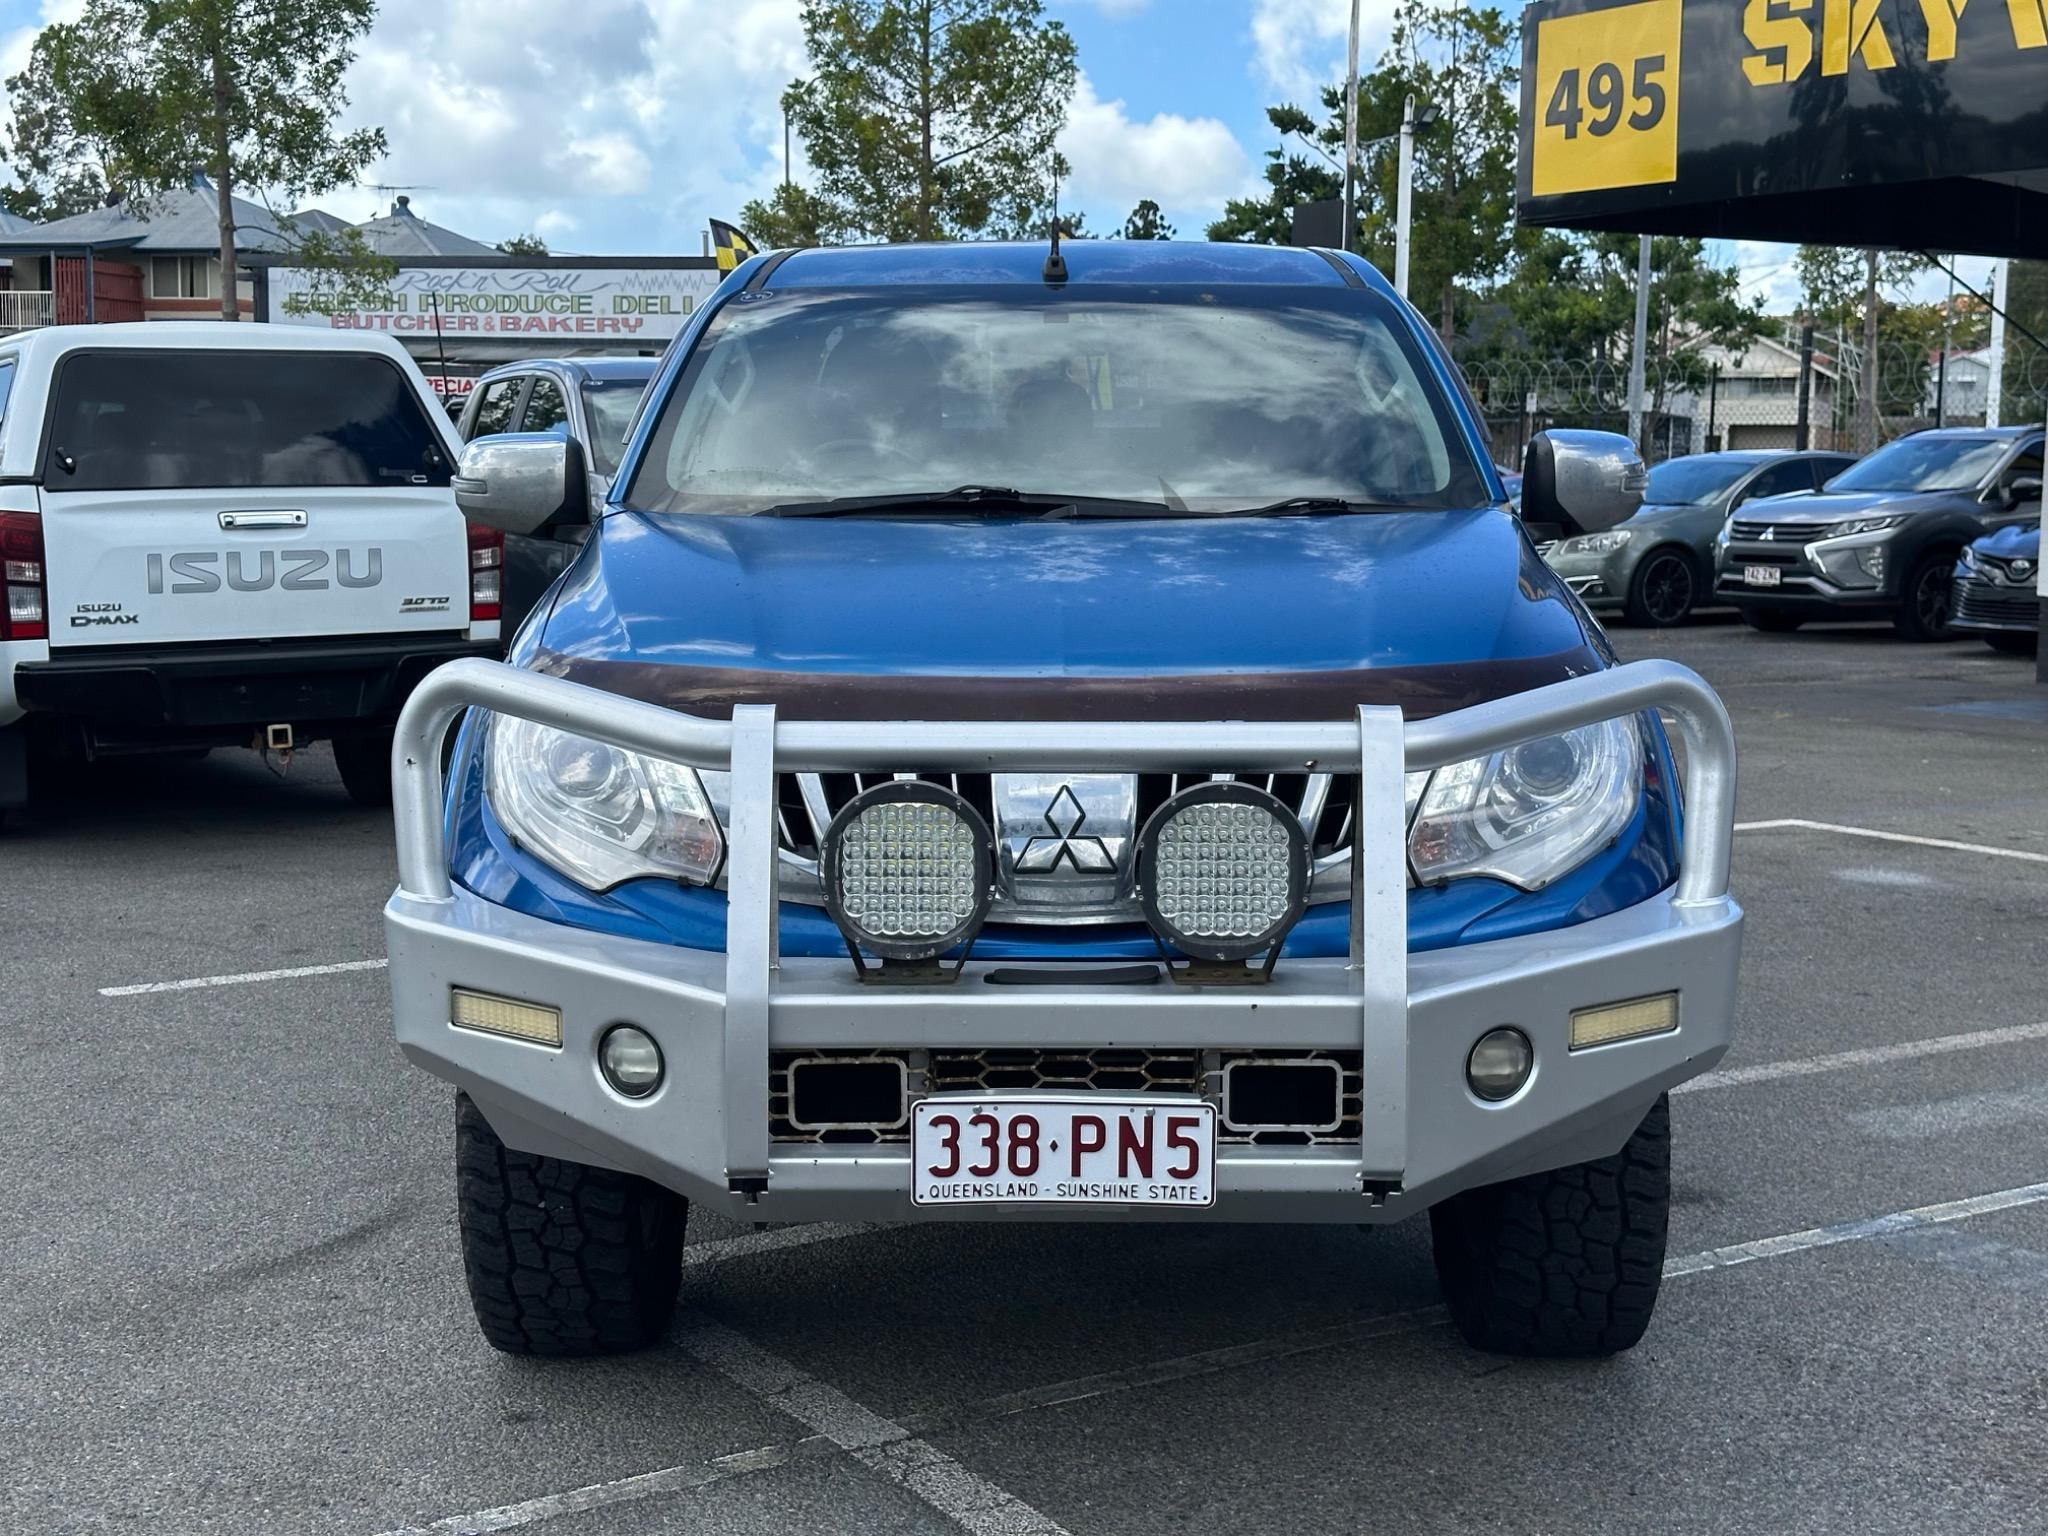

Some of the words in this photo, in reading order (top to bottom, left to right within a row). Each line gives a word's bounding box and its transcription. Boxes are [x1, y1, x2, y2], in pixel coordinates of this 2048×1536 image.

[1545, 54, 1666, 140] 495
[508, 271, 584, 293] Roll
[419, 294, 593, 314] PRODUCE
[613, 294, 694, 315] DELI
[331, 314, 479, 331] BUTCHER
[483, 315, 496, 332] &
[500, 315, 644, 333] BAKERY
[147, 547, 383, 595] ISUZU
[77, 602, 122, 613] ISUZU
[928, 1114, 1040, 1178] 338
[1071, 1115, 1200, 1179] PN5
[929, 1183, 1039, 1199] QUEENSLAND
[1056, 1183, 1140, 1199] SUNSHINE
[1149, 1185, 1199, 1200] STATE
